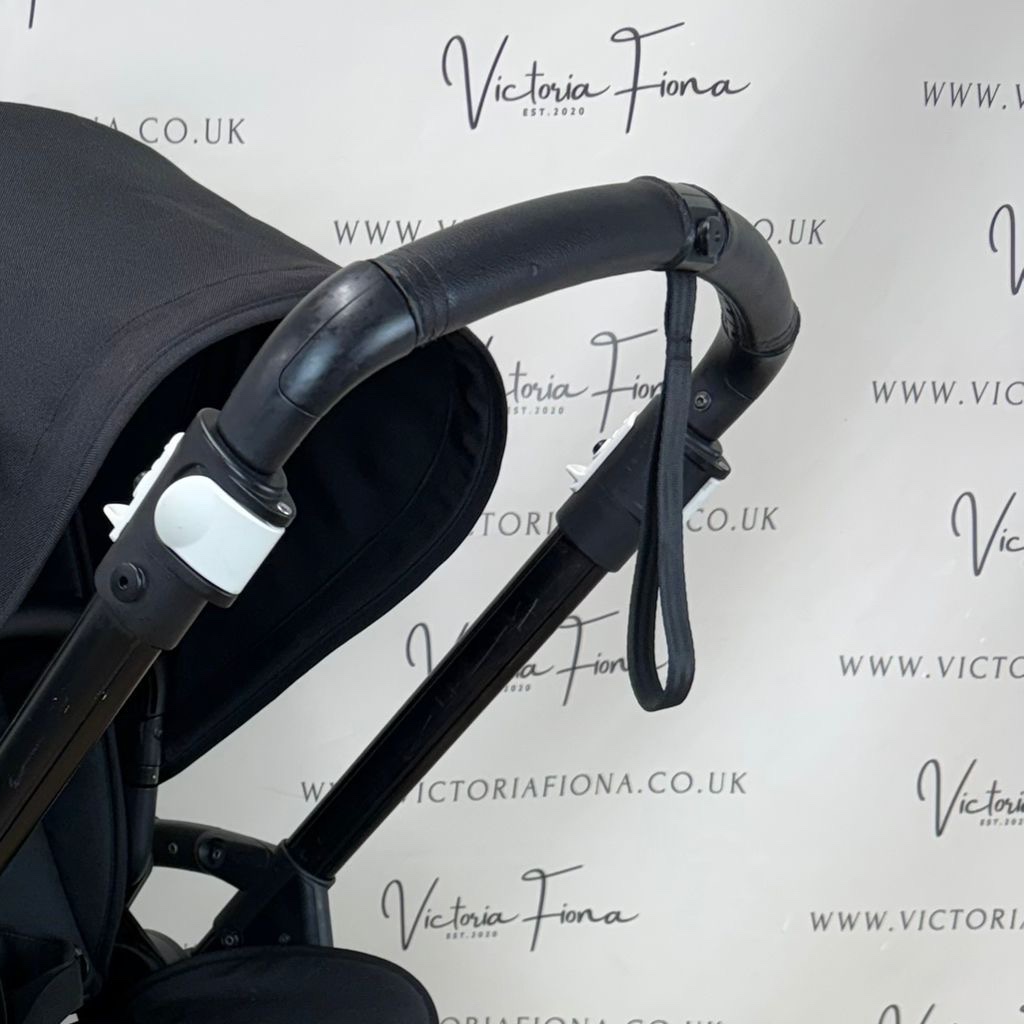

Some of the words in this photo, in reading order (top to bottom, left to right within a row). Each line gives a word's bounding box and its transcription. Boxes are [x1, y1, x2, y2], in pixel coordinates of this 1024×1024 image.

[441, 34, 611, 130] Victoria
[610, 22, 751, 134] Fiona
[523, 107, 584, 117] EST.2020
[590, 328, 664, 433] Fion
[381, 877, 520, 951] Victoria
[521, 864, 639, 952] Fiona
[810, 908, 1024, 932] WWW.VICTORI
